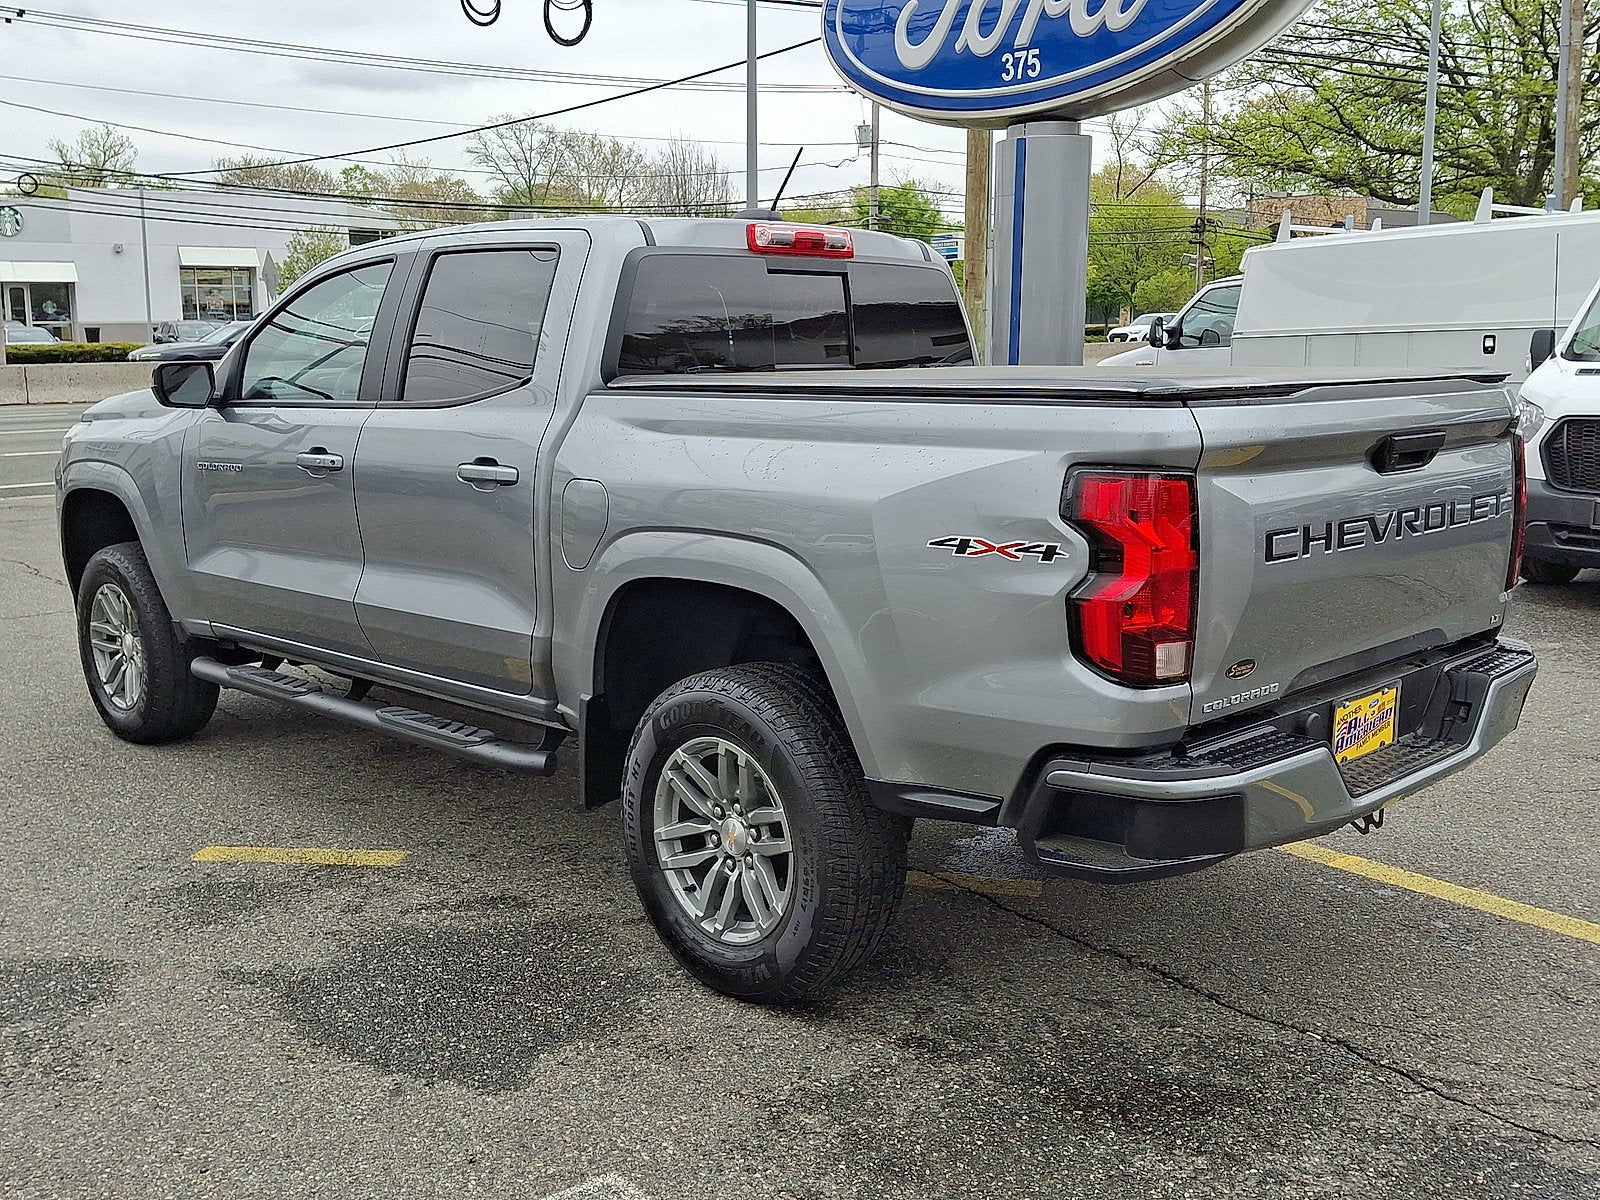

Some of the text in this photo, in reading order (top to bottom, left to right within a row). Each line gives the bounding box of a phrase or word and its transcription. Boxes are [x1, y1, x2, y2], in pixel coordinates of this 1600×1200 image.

[1001, 48, 1041, 82] 375
[1264, 491, 1512, 565] CHEVROLET
[1202, 682, 1280, 714] COLORADO
[1336, 705, 1363, 727] ANOTHER
